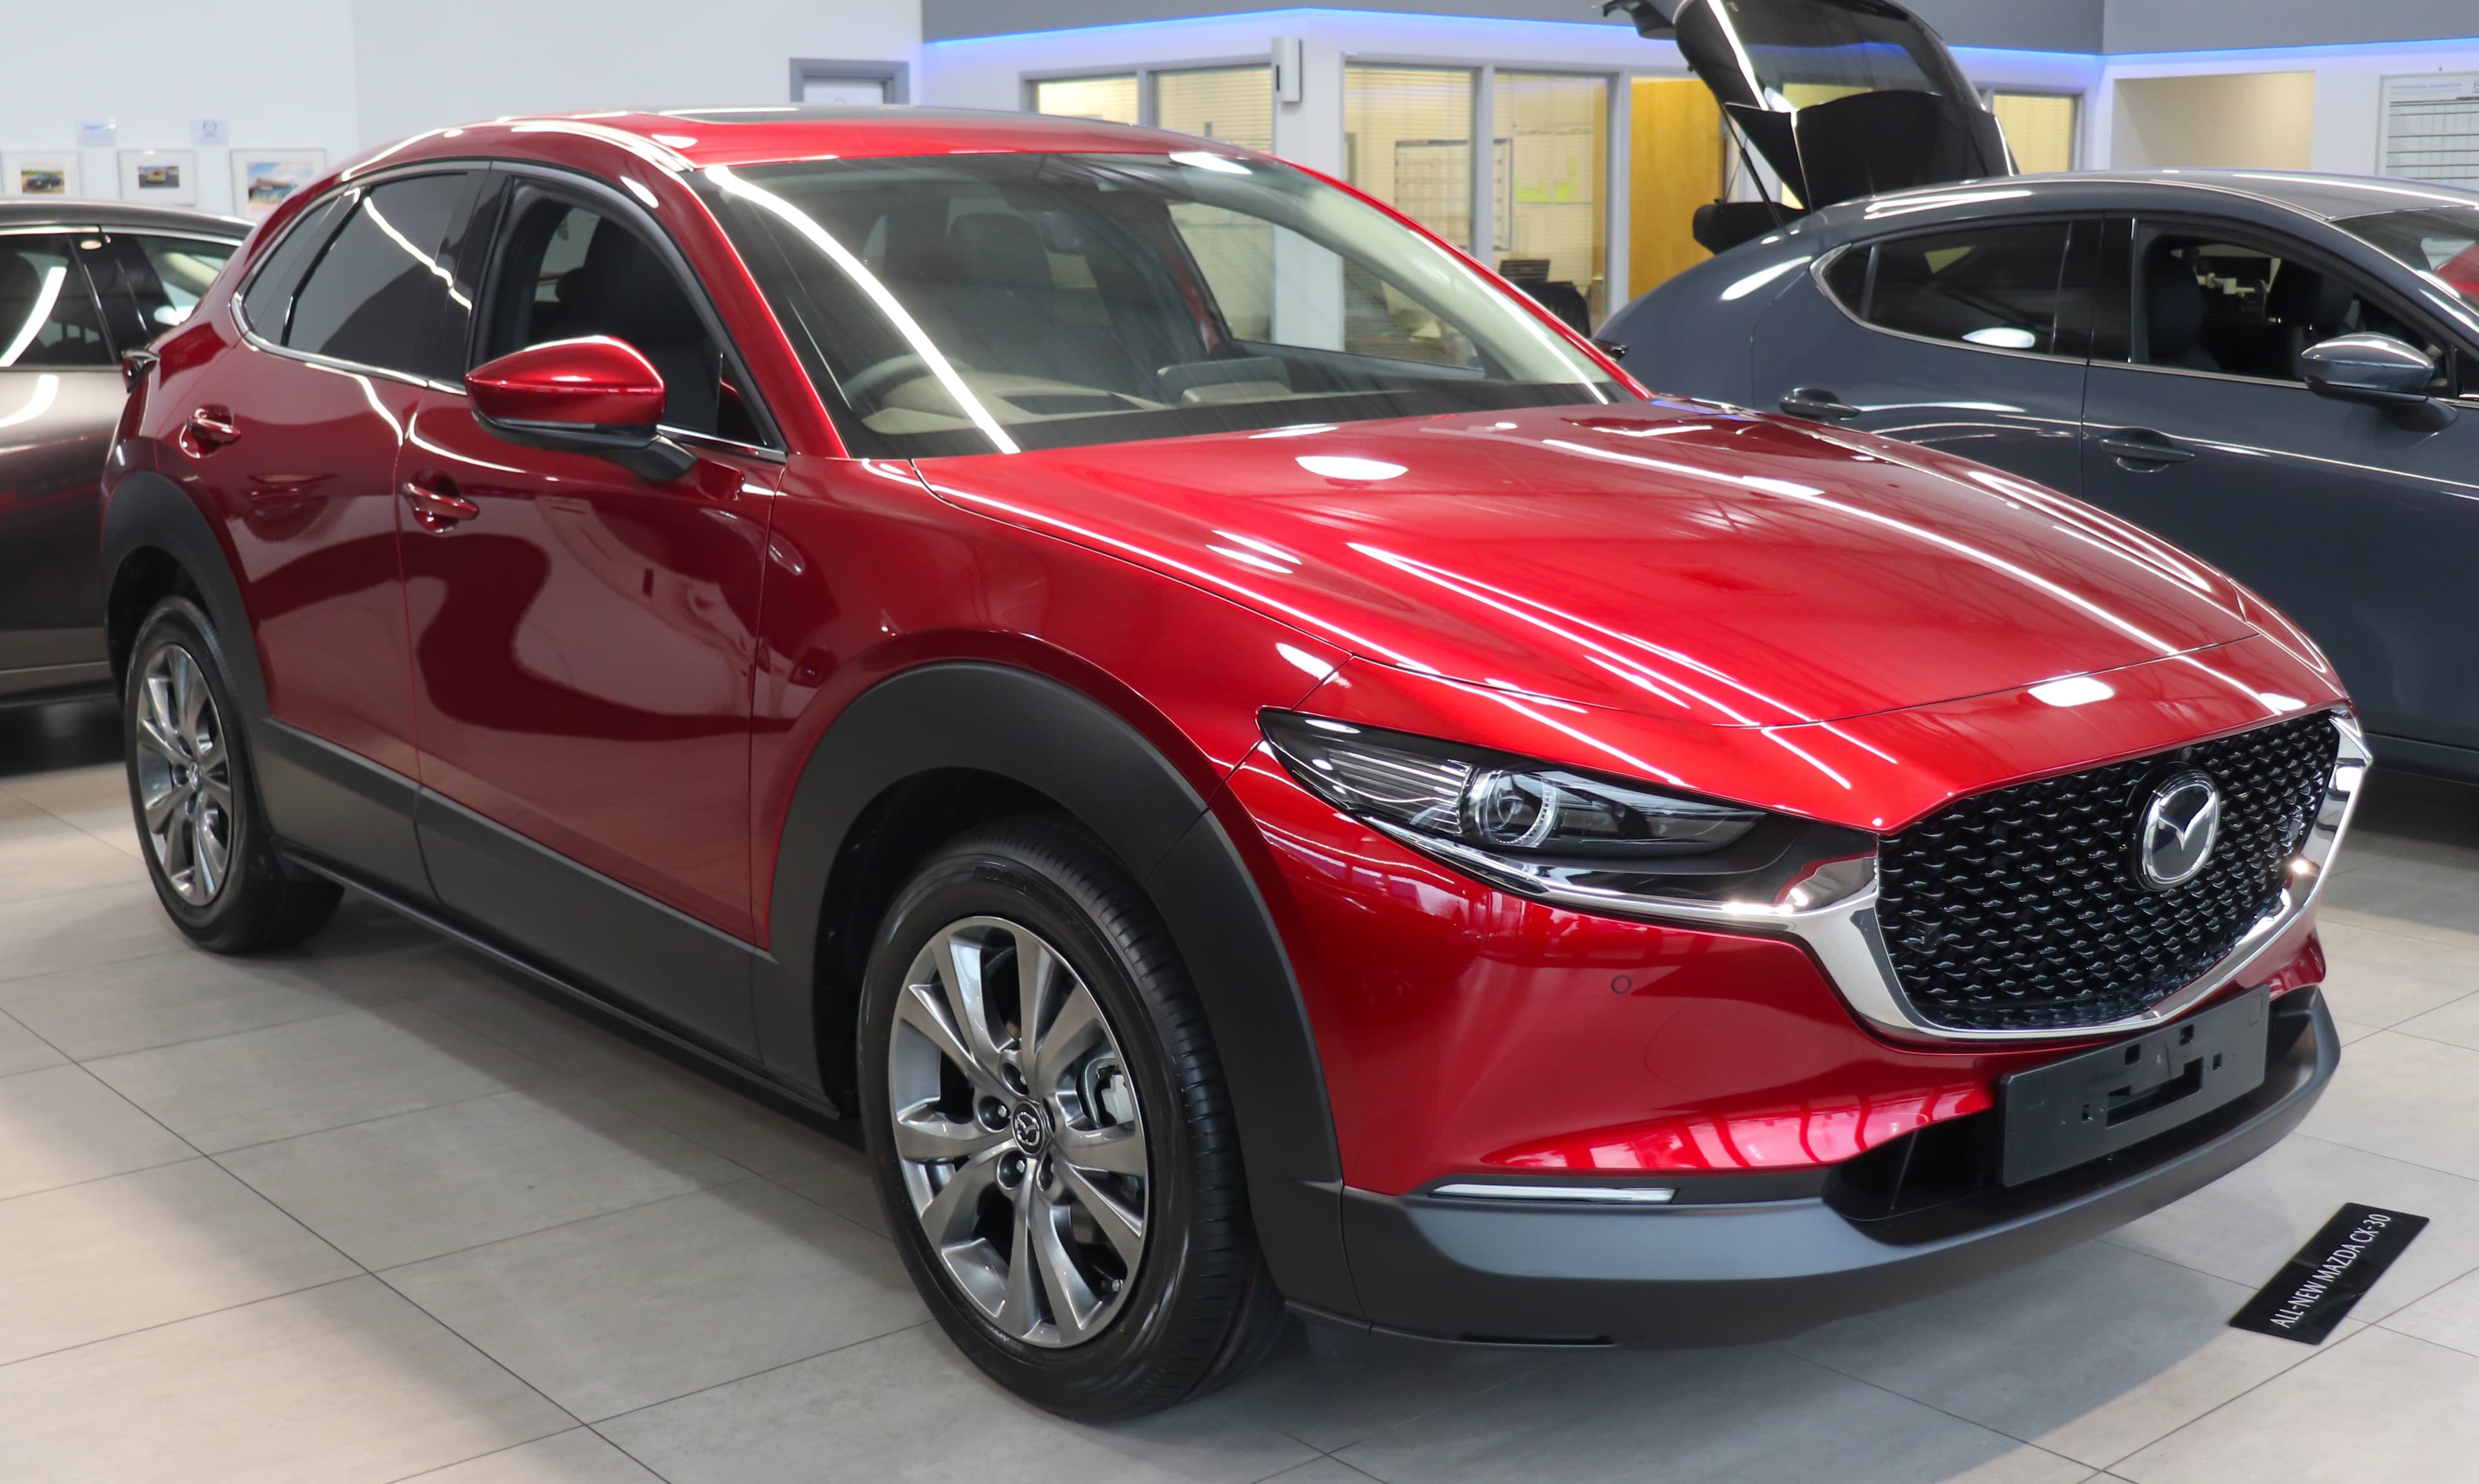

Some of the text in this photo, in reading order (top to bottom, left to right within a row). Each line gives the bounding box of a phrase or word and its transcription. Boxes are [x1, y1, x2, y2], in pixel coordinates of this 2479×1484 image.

[2269, 1213, 2392, 1328] ALL-NEW MAZDA CX-30
